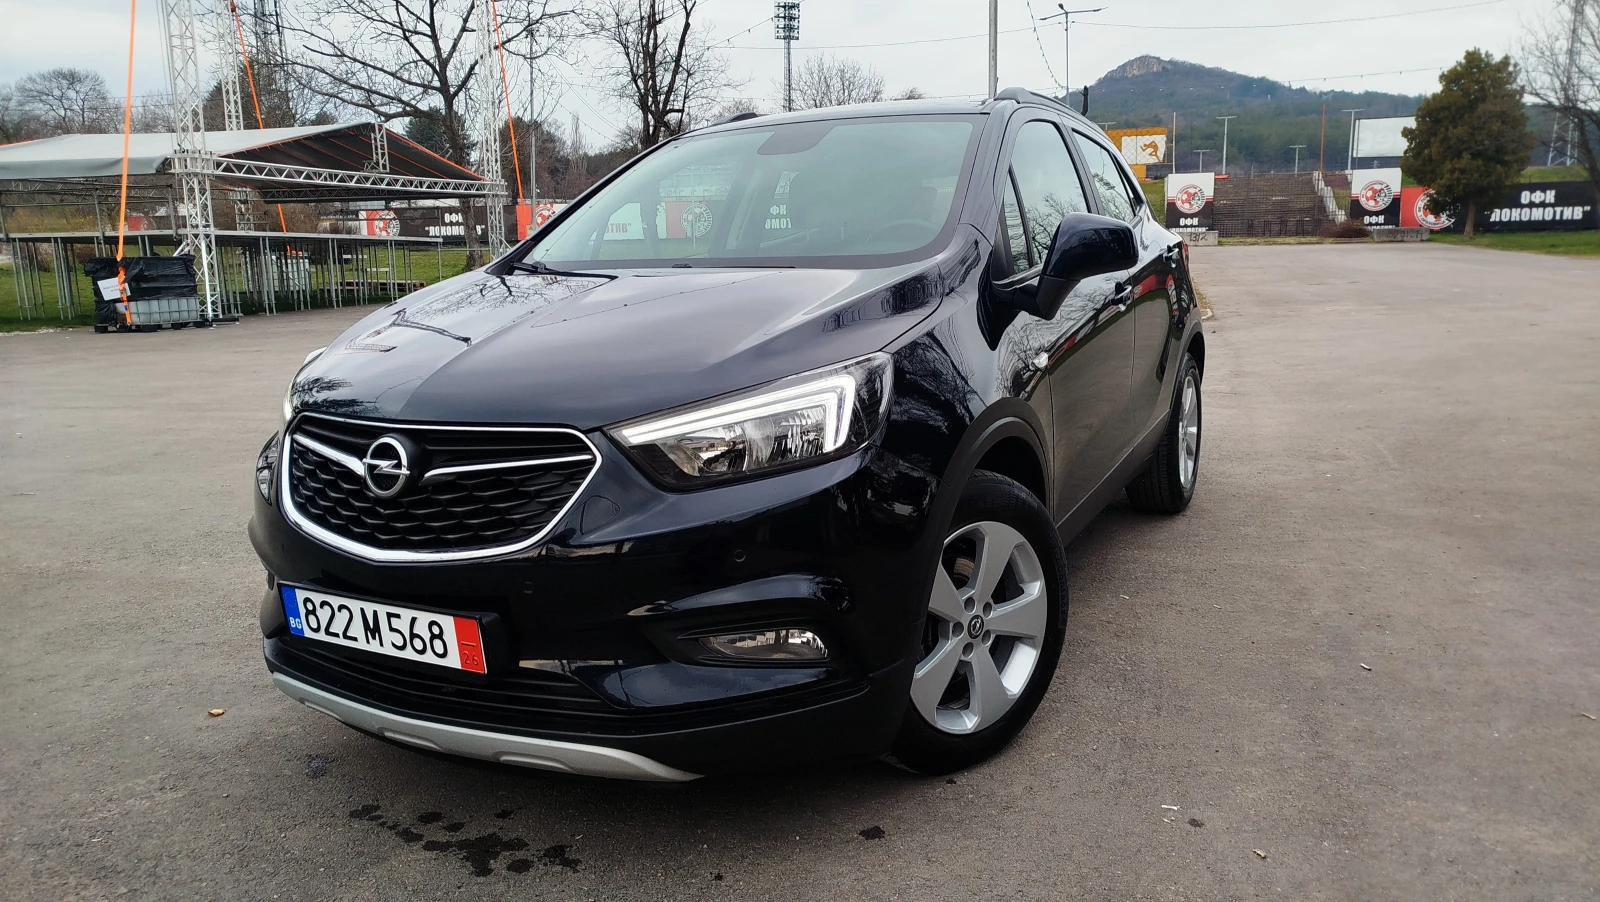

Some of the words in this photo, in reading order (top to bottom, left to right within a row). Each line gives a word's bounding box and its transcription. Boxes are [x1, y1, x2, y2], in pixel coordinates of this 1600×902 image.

[1520, 190, 1556, 204] ОФК
[1180, 217, 1198, 226] ОФК
[1363, 215, 1385, 225] ОФК
[289, 616, 302, 629] BG
[462, 650, 479, 666] 26
